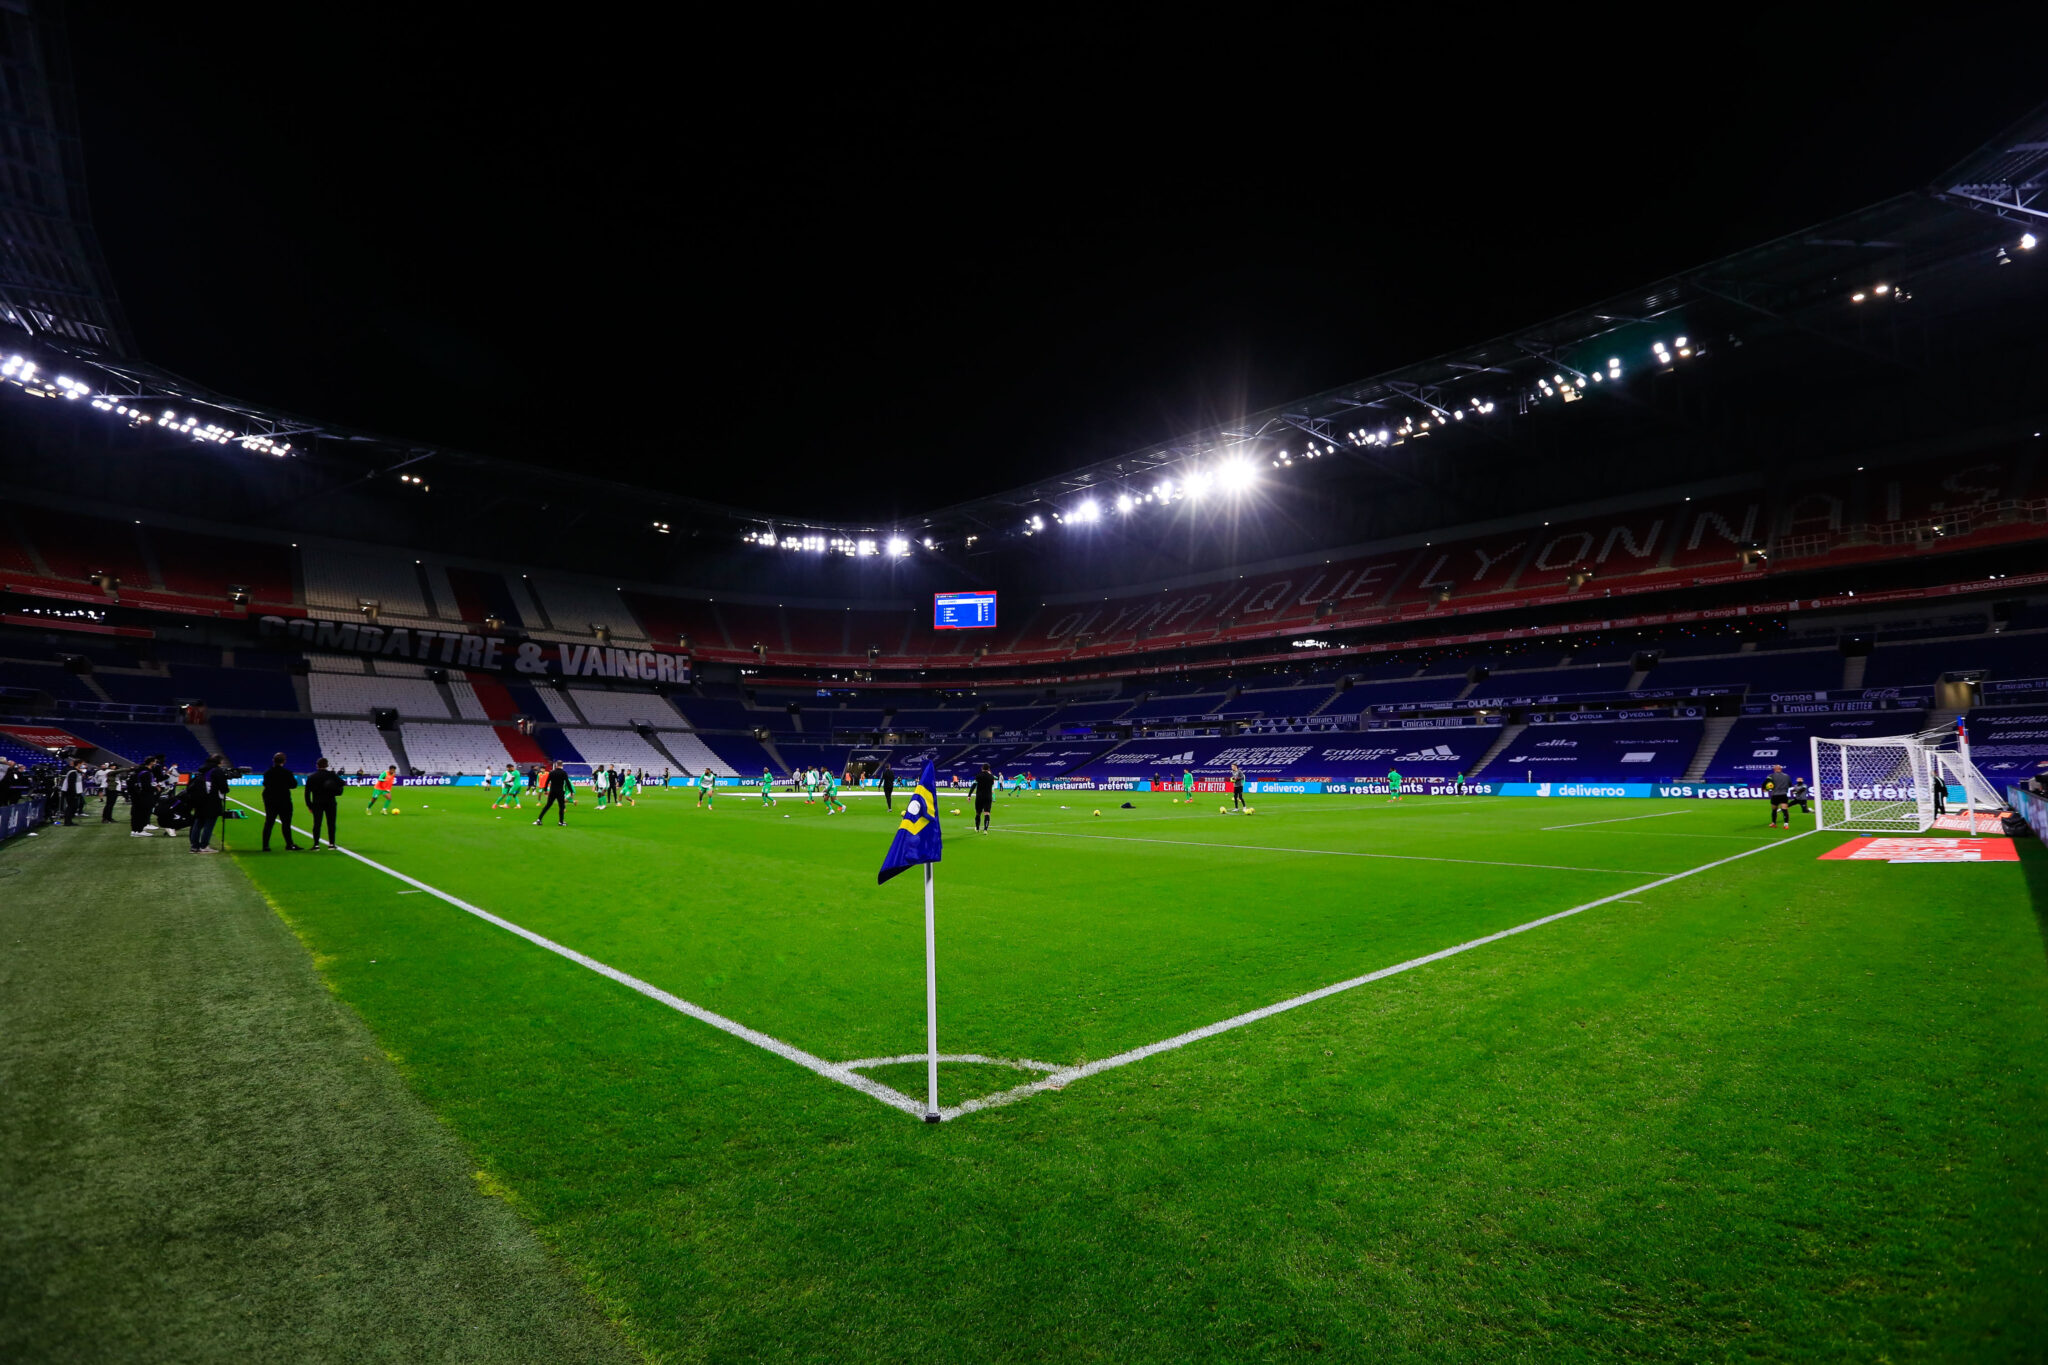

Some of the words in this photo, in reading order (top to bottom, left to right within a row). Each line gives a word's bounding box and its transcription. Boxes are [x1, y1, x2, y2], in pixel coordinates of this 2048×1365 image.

[1702, 609, 1737, 618] Orange
[1752, 603, 1788, 614] Orange
[259, 615, 505, 671] COMBATTRE
[515, 641, 549, 675] &
[558, 643, 691, 684] VAINCRE
[1770, 692, 1812, 704] Orange
[1782, 702, 1830, 713] Emirates
[1832, 702, 1848, 712] FLY
[1848, 700, 1873, 711] BETTER
[1401, 718, 1433, 728] Emirates
[1321, 748, 1399, 756] Emirates
[402, 776, 452, 787] préférés
[1038, 782, 1051, 790] vos
[1052, 781, 1096, 791] restaurants
[1098, 781, 1134, 792] préférés
[1197, 782, 1209, 792] FLY
[1209, 782, 1226, 792] BETTER
[1262, 783, 1305, 793] deliveroo
[1326, 784, 1347, 793] vos
[1558, 783, 1626, 797] deliveroo
[1659, 787, 1693, 798] vos
